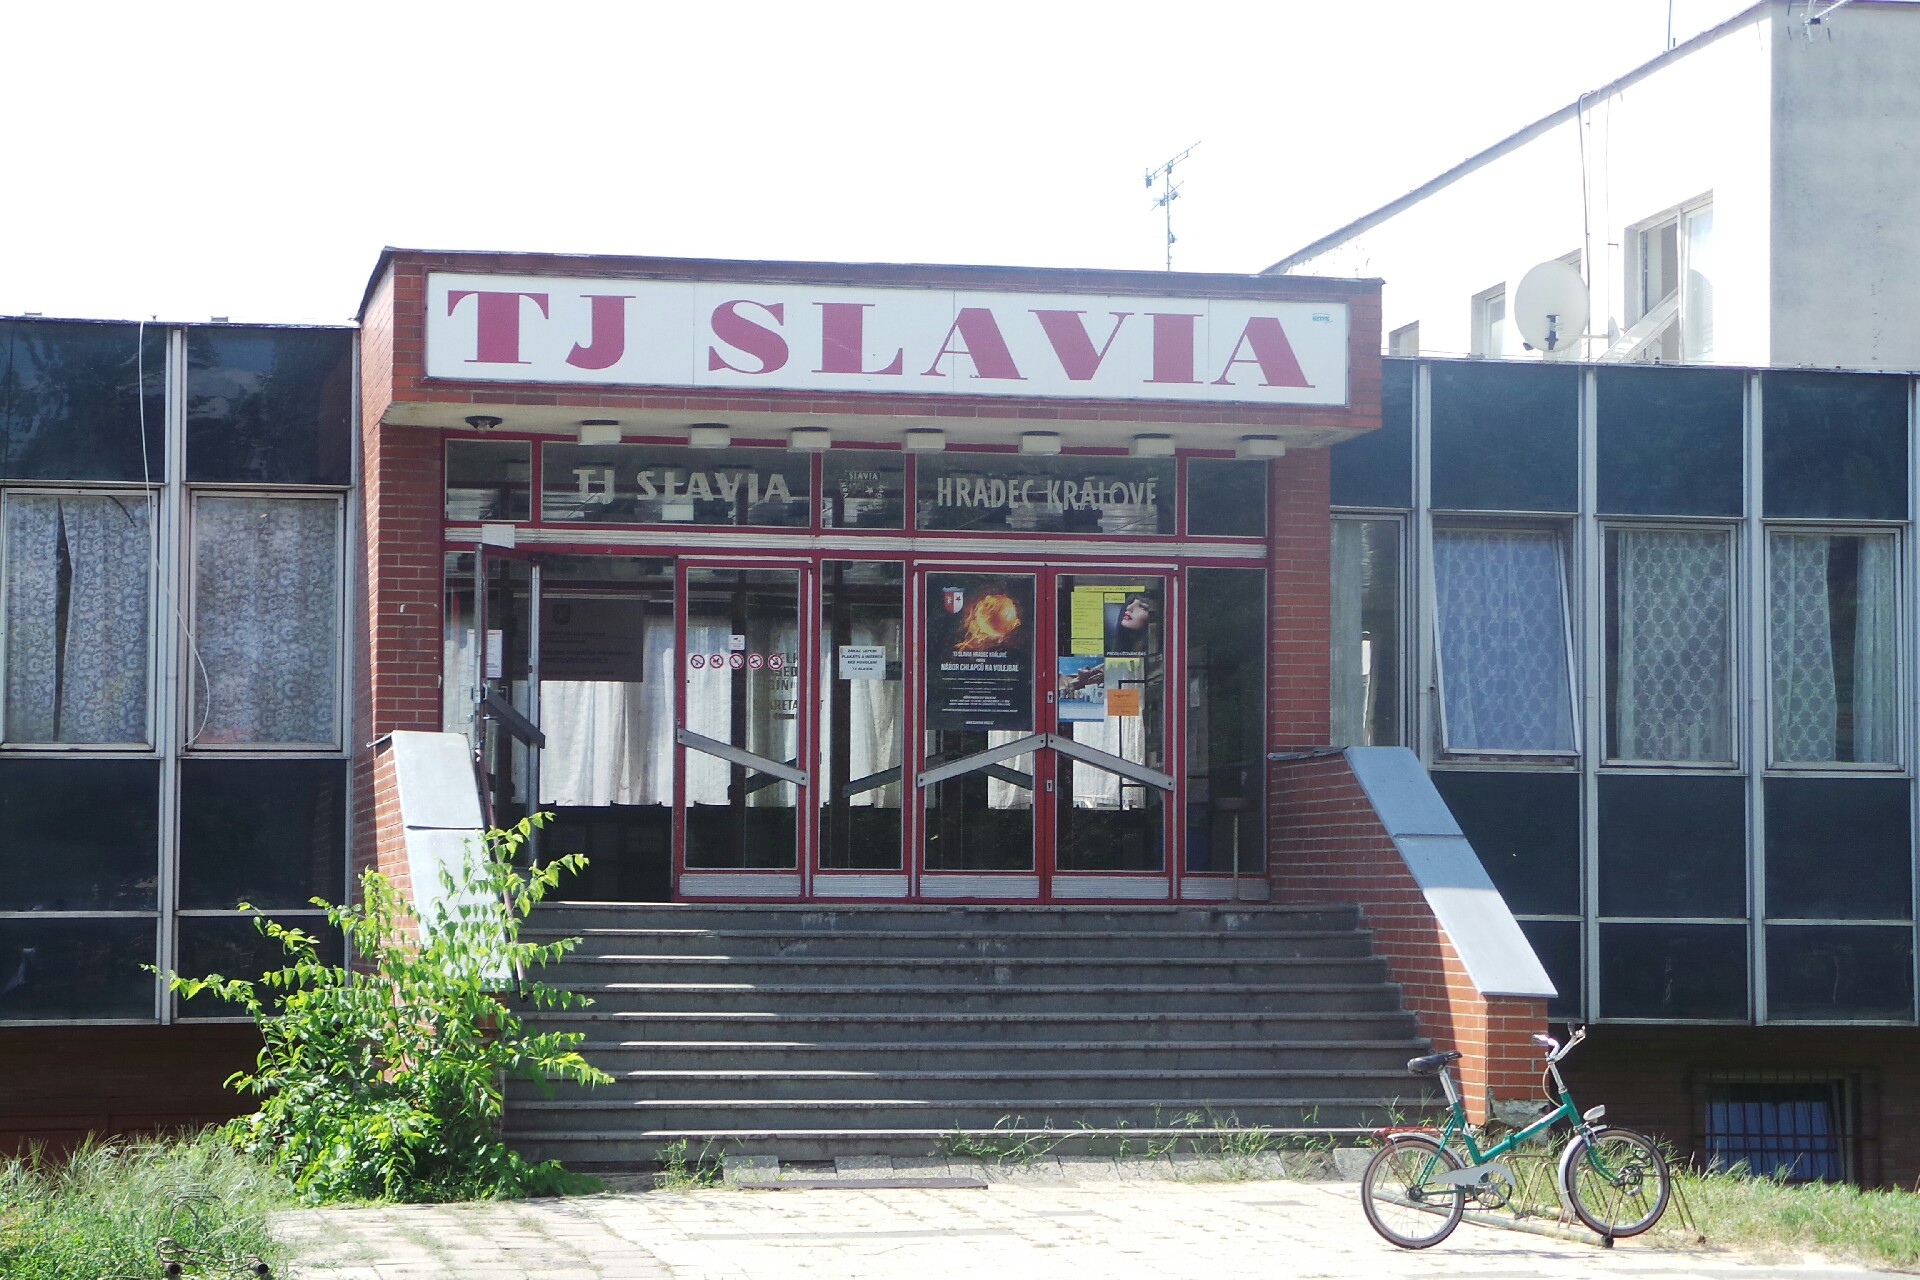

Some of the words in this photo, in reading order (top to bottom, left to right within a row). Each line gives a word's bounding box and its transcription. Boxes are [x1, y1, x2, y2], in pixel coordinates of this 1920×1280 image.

[447, 289, 637, 370] TJ
[708, 299, 1316, 388] SLAVIA
[572, 468, 616, 504] TJ
[636, 469, 793, 503] SLAVIA
[849, 471, 879, 481] SLAVIA
[937, 476, 1034, 509] HRADEC
[1047, 475, 1158, 511] KRÁLOVÉ
[940, 661, 960, 671] NÁBOR
[960, 662, 985, 672] CHLAPCŮ
[993, 664, 1020, 672] VOLEJBAL
